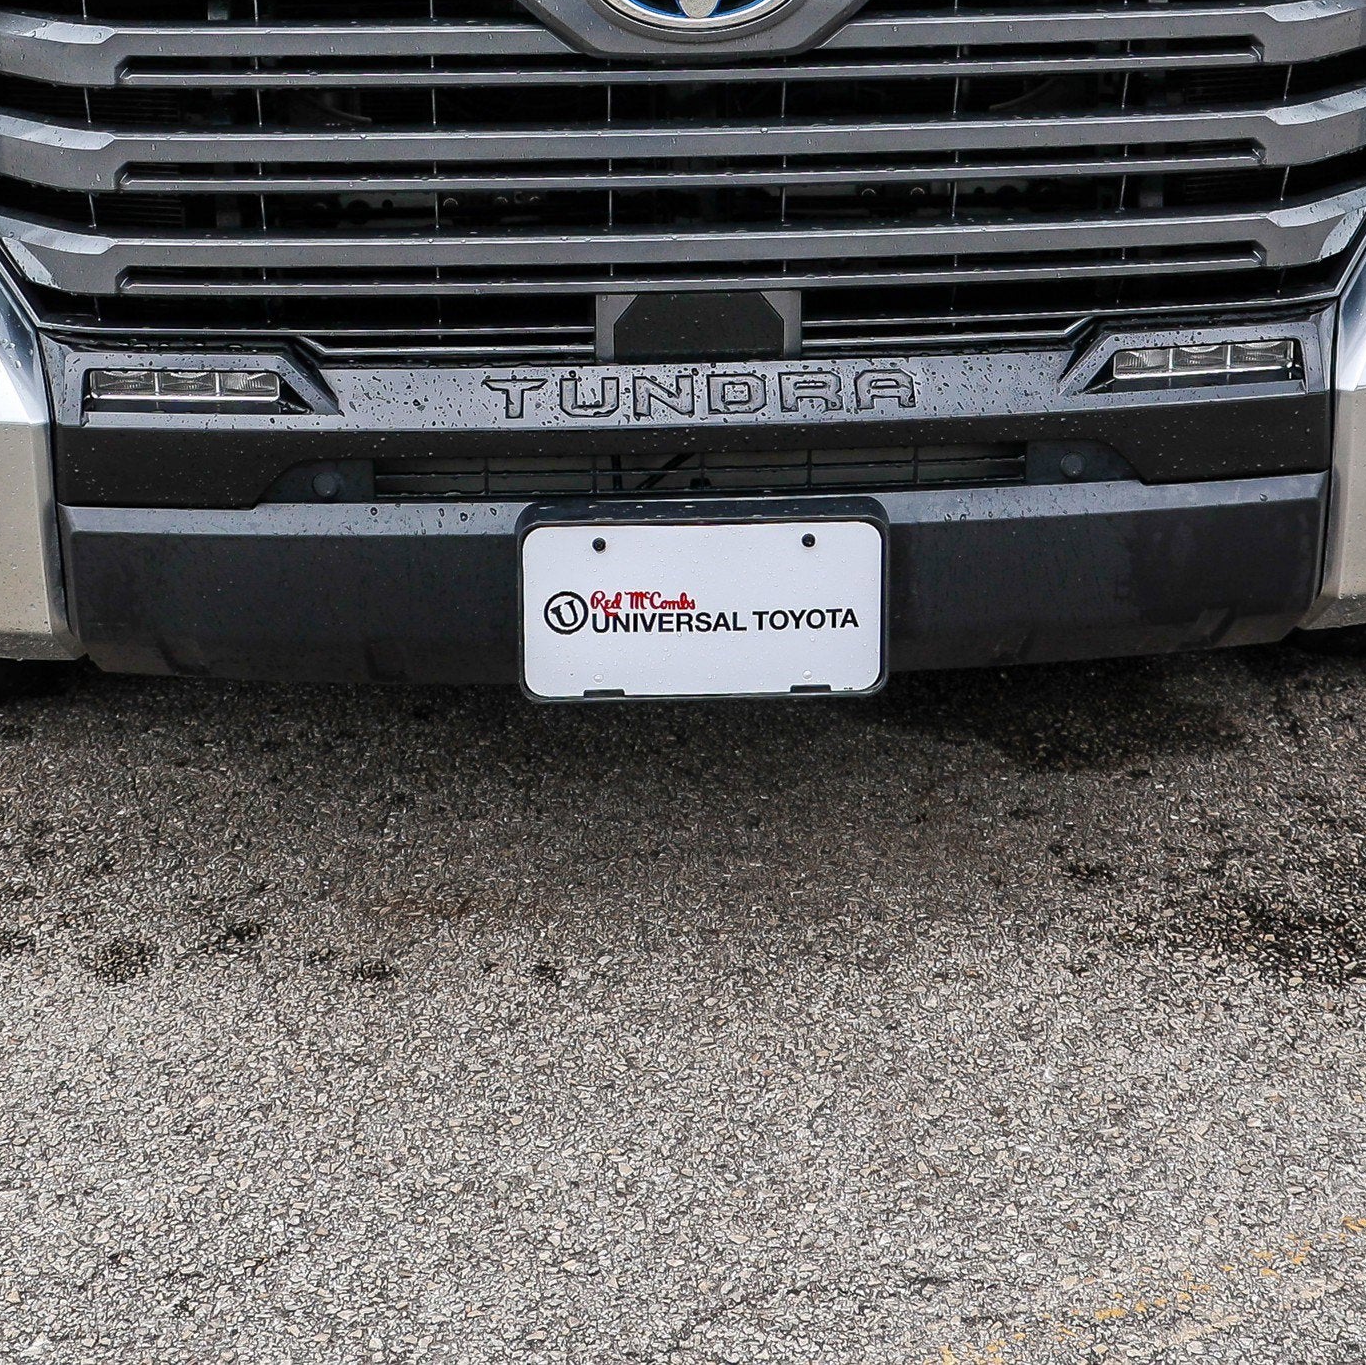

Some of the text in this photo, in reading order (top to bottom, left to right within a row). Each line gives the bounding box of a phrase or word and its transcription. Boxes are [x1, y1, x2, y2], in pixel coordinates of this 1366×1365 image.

[481, 367, 918, 420] TUNDRA
[590, 590, 696, 614] Red McCombs
[592, 608, 859, 633] UNIVERSAL TOYOTA
